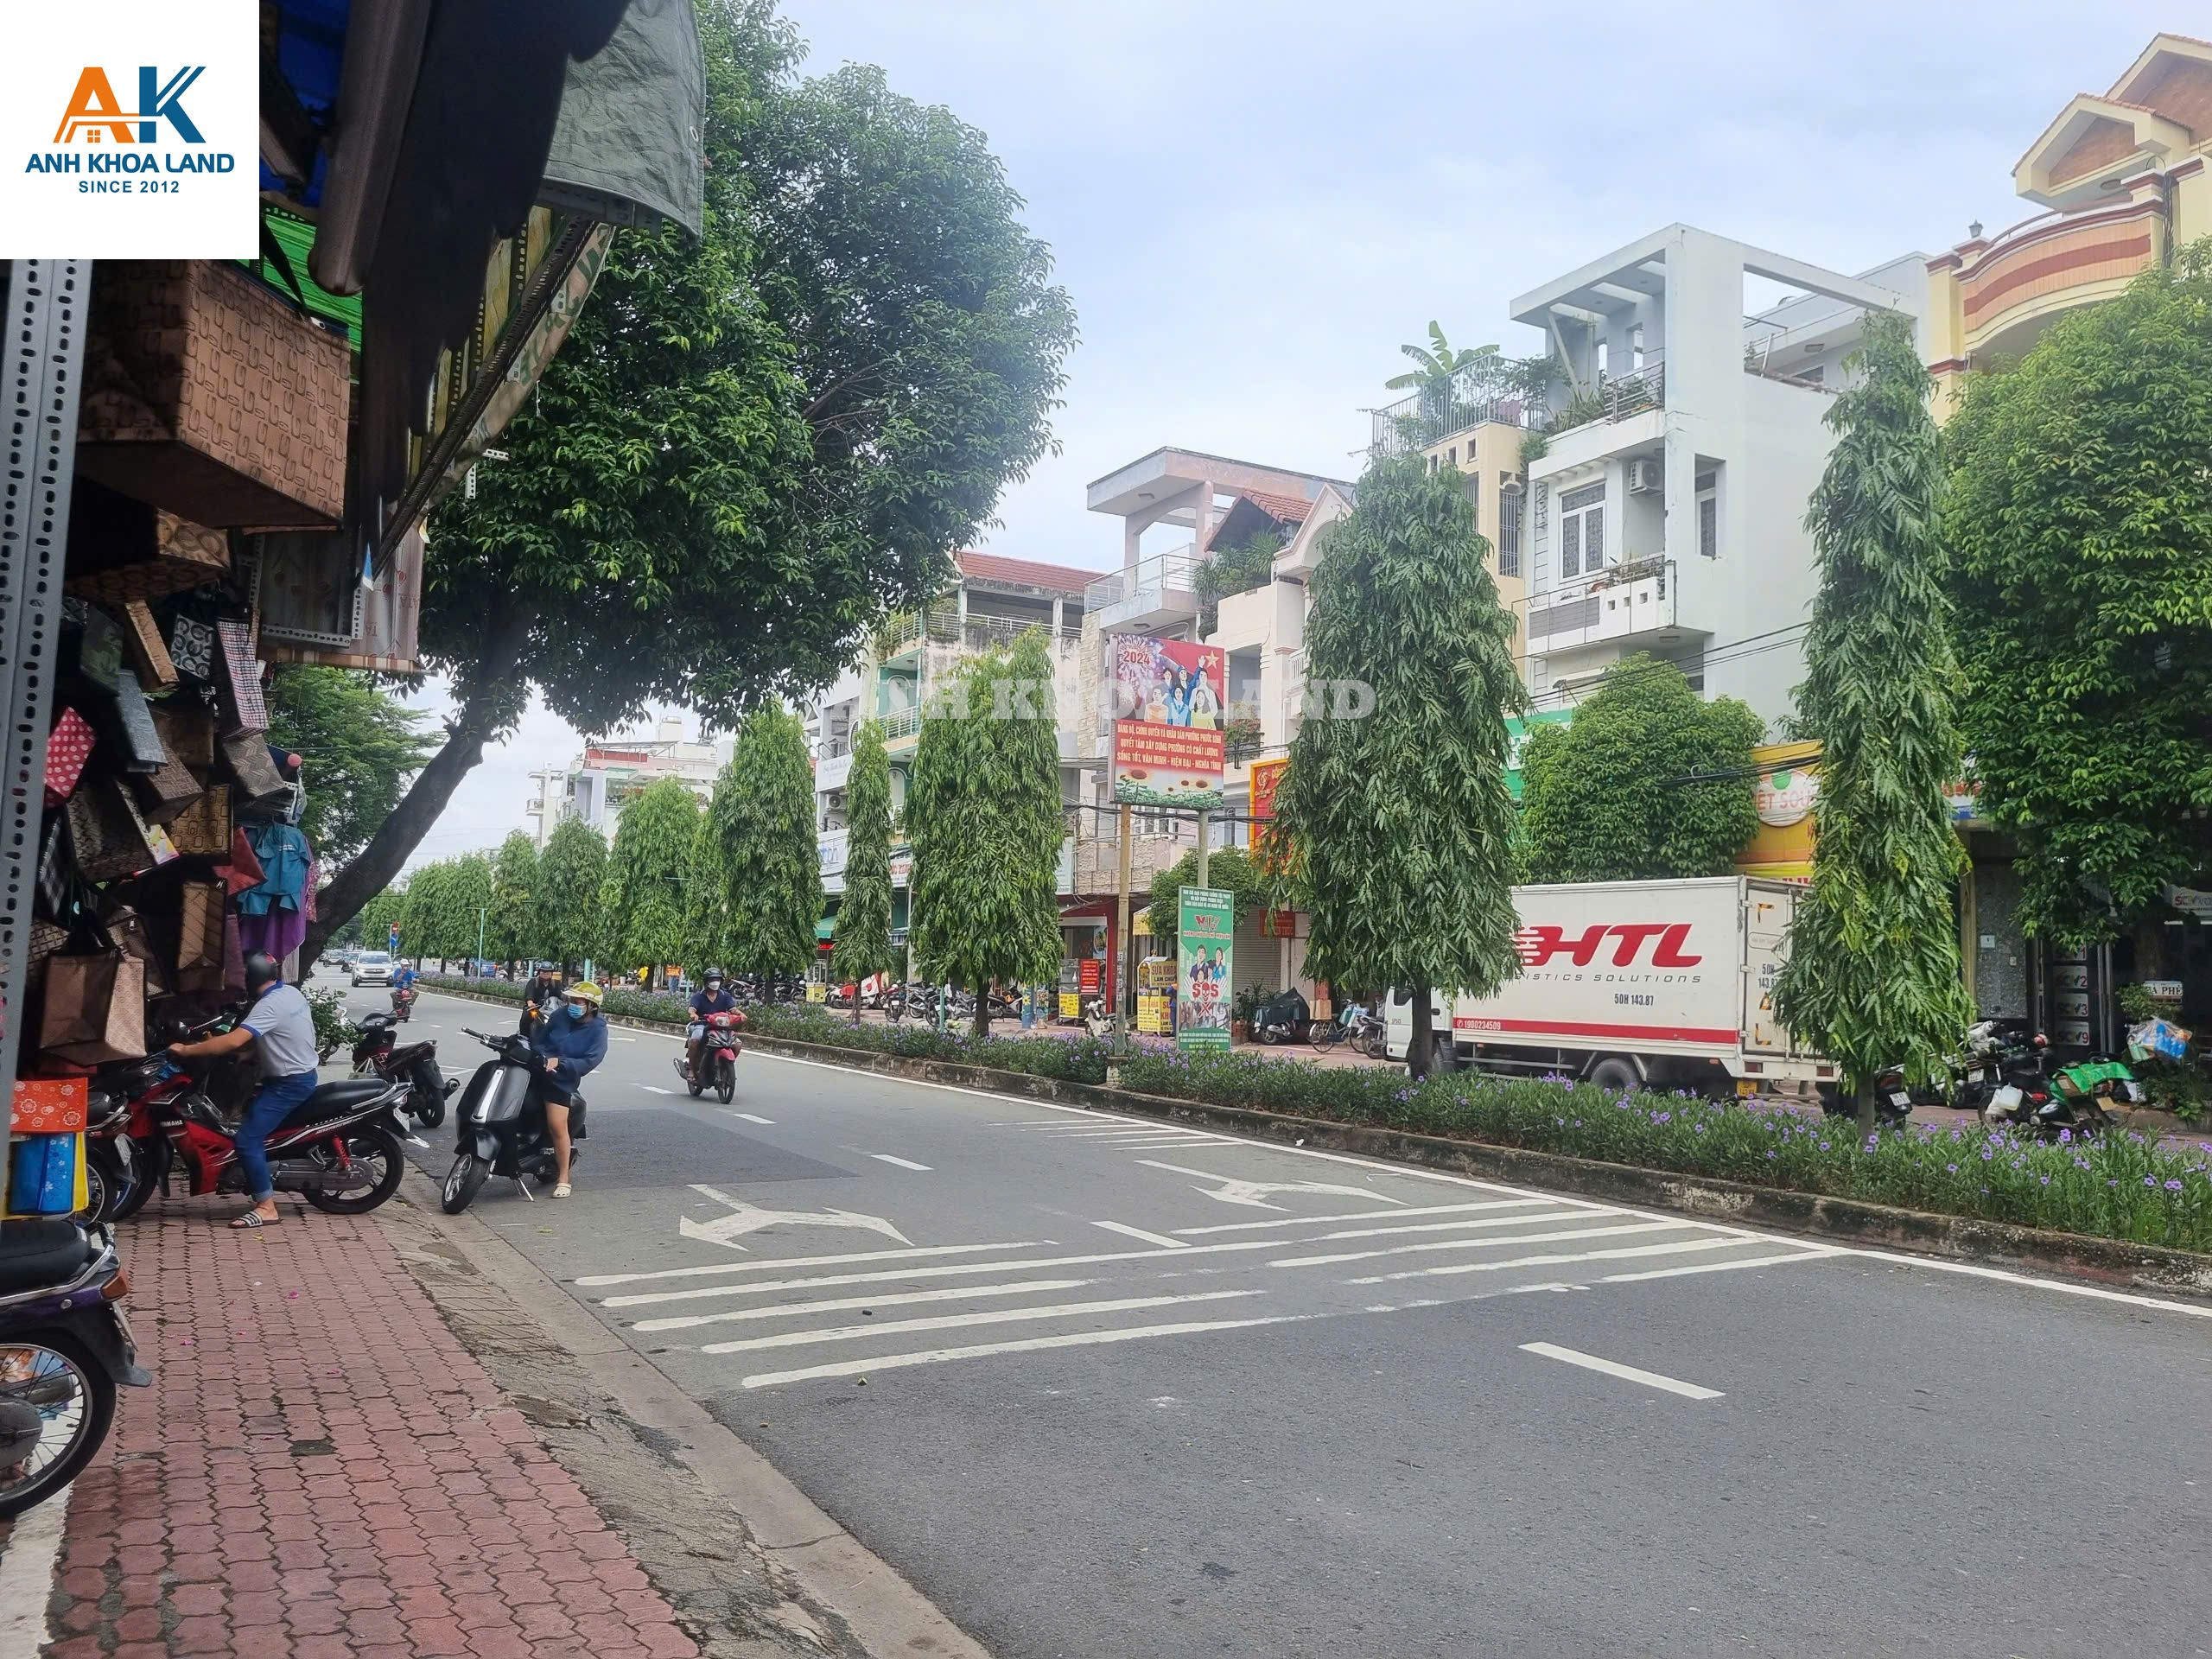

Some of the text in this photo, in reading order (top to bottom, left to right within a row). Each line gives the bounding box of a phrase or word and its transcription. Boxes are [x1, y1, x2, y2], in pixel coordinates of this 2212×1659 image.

[1123, 651, 1150, 664] 2024
[1120, 736, 1135, 748] QUYẾT
[1135, 738, 1145, 749] TÂM
[1145, 739, 1154, 750] XÂY
[1154, 741, 1167, 753] DỰNG
[1116, 749, 1131, 761] SỐNG
[1153, 754, 1166, 766] MINH
[1170, 755, 1182, 768] HIỆN
[1514, 923, 1702, 968] HTL
[1503, 972, 1701, 983] GISTICS SOLUTIONS
[1614, 993, 1654, 1006] 50H 143.87
[1464, 1020, 1501, 1030] 1900234509
